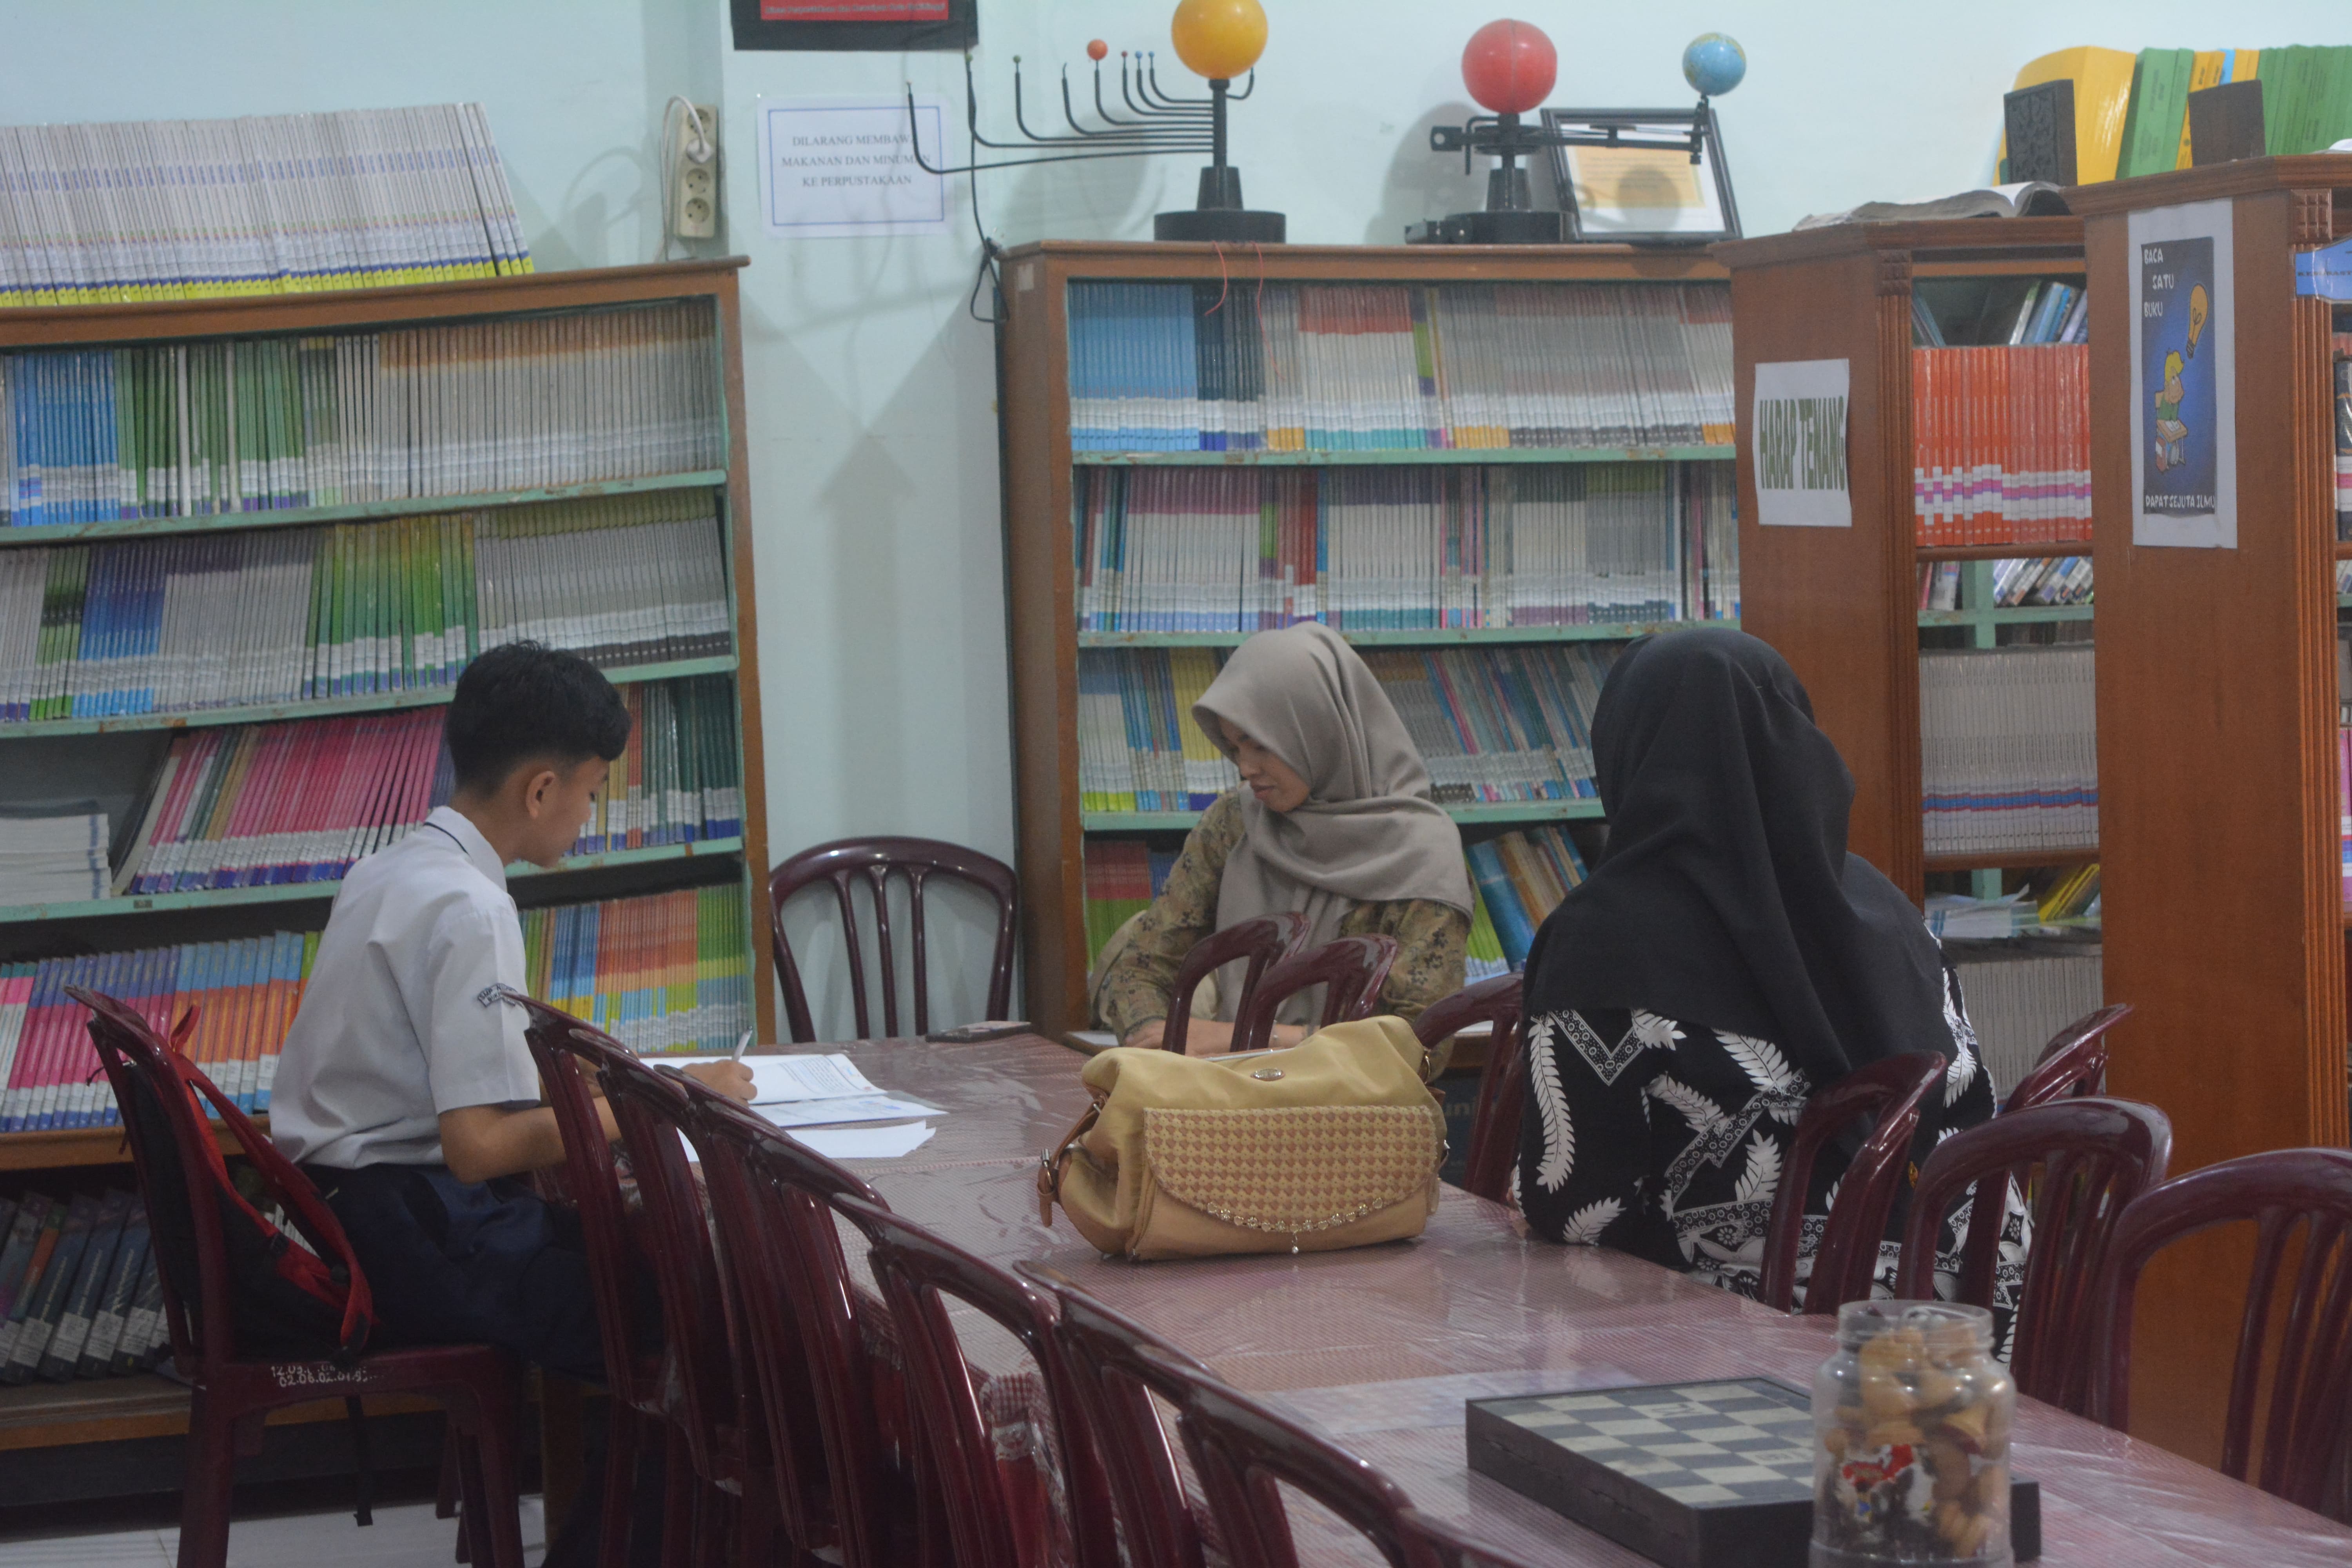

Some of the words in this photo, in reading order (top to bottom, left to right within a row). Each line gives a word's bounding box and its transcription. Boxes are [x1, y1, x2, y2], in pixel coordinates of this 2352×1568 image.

[792, 135, 853, 146] DILARANG
[782, 156, 842, 167] MAKANAN
[846, 156, 870, 166] DAN
[802, 177, 818, 187] KE
[821, 175, 912, 186] PERPUSTAKAAN
[2144, 247, 2163, 265] BACA
[2152, 273, 2174, 290] SATU
[2144, 301, 2163, 318] BUKU
[1759, 398, 1797, 490] HARAP
[1798, 395, 1844, 491] TENANG
[2145, 494, 2169, 508] DAPAT
[2169, 495, 2195, 508] SEJUTA
[2196, 494, 2215, 508] ILMU
